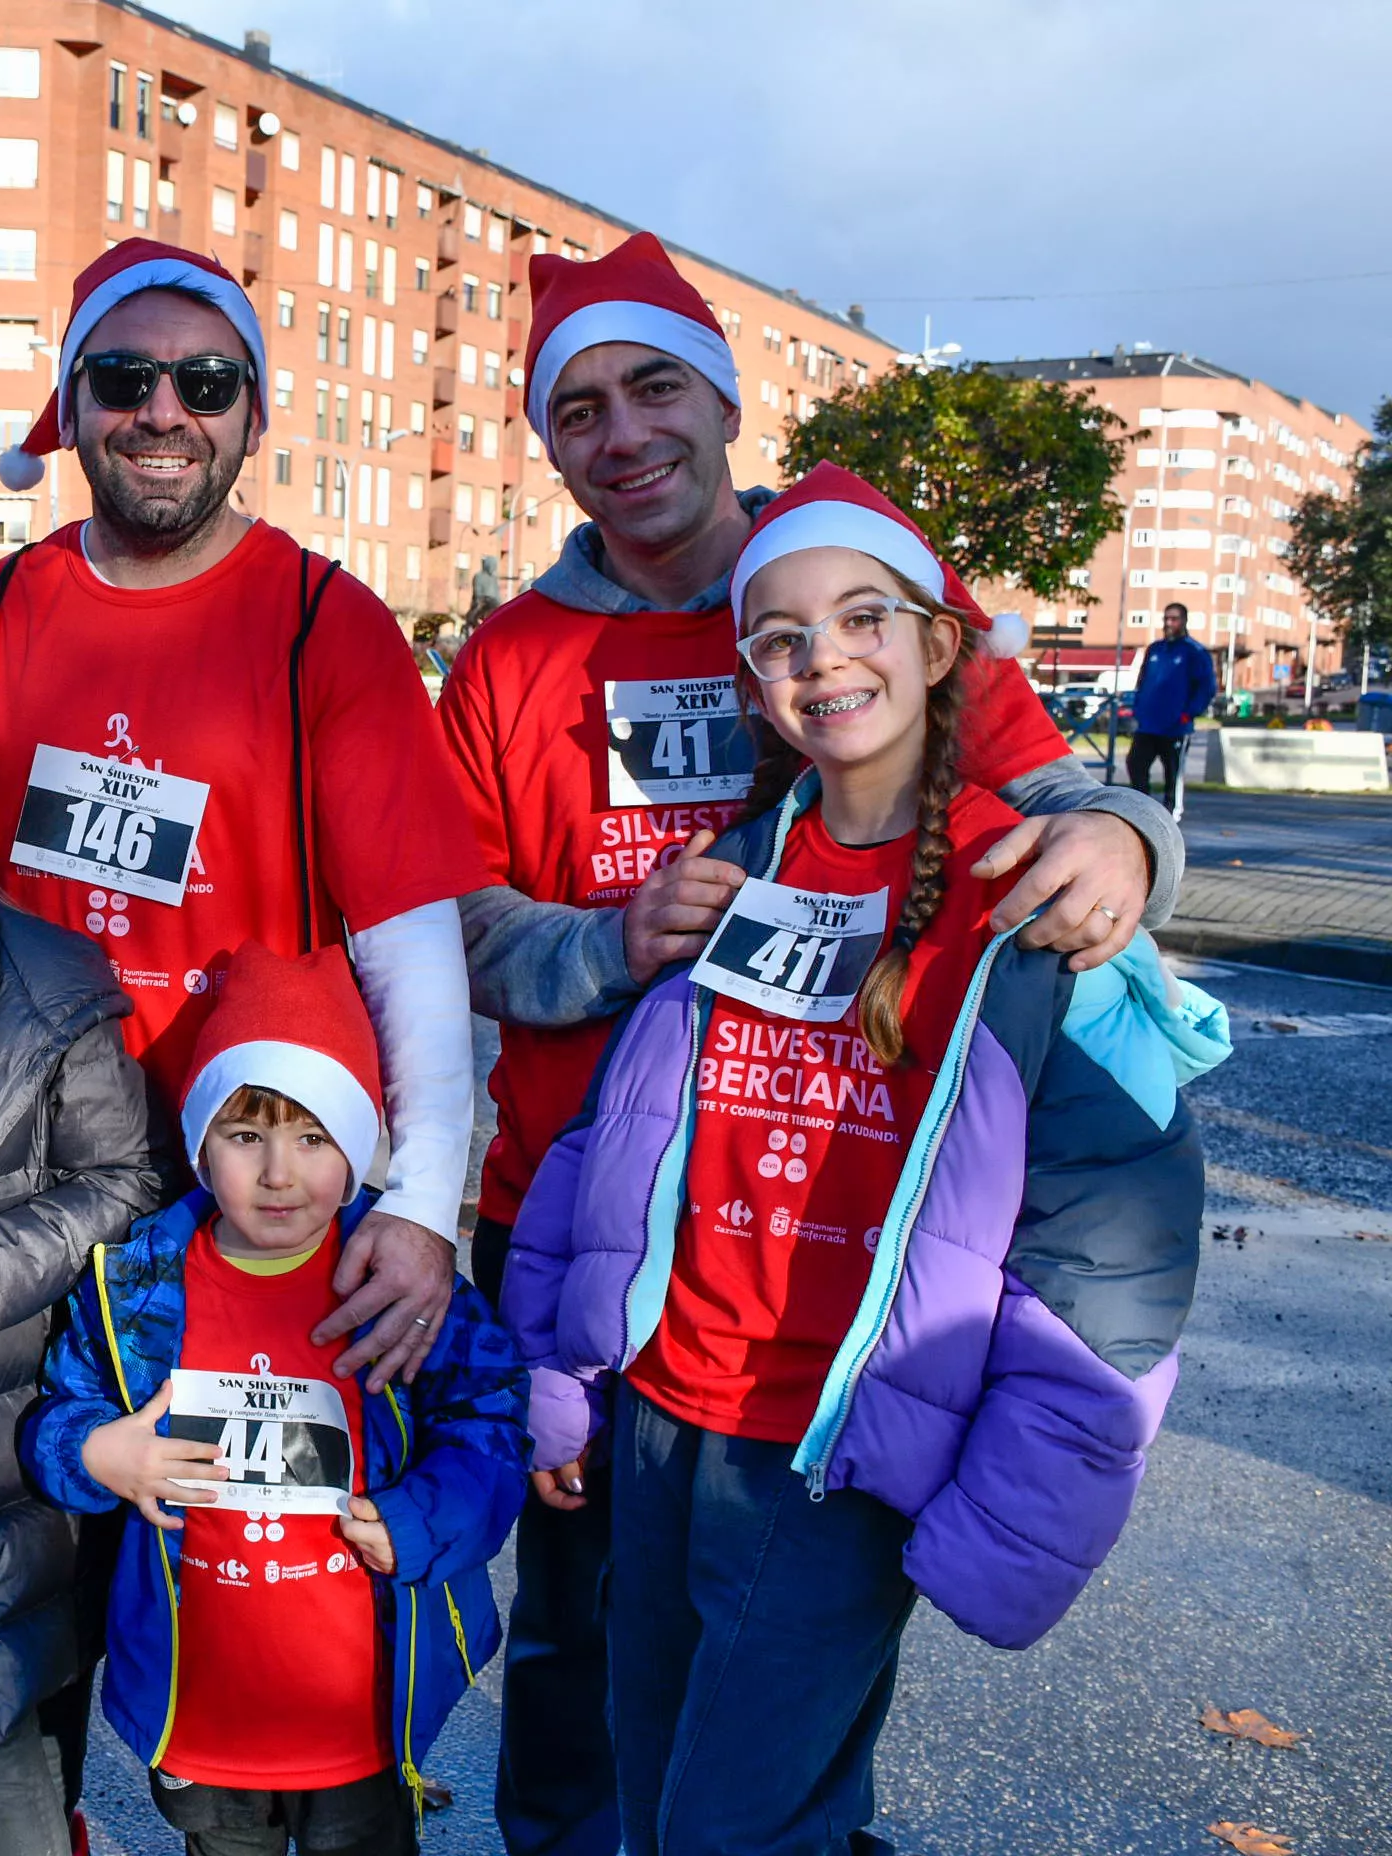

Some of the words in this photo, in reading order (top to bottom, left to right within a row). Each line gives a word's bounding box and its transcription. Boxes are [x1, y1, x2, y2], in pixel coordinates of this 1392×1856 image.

[650, 685, 674, 694] SAN
[675, 692, 723, 710] XLIV
[652, 720, 711, 776] 41
[80, 762, 104, 774] SAN
[107, 768, 160, 788] SILVESTRE
[98, 778, 144, 800] XLIV
[600, 805, 735, 847] SILVEST
[65, 800, 157, 871] 146
[591, 845, 686, 883] BERC
[793, 896, 817, 906] SAN
[809, 910, 852, 928] XLIV
[747, 929, 843, 995] 411
[122, 968, 170, 979] Ayuntamiento
[122, 977, 169, 988] Ponferrada
[714, 1020, 884, 1076] SILVESTRE
[697, 1058, 894, 1122] BERCIANA
[698, 1100, 716, 1112] ETE
[720, 1102, 726, 1112] Y
[730, 1105, 789, 1124] COMPARTE
[791, 1114, 834, 1131] TIEMPO
[714, 1224, 752, 1238] Carrefour
[793, 1218, 848, 1234] Ayuntamiento
[791, 1228, 846, 1244] Ponferrada
[218, 1378, 244, 1388] SAN
[248, 1380, 310, 1394] SILVESTRE
[244, 1391, 294, 1410] XLIV
[212, 1418, 286, 1484] 44
[194, 1556, 209, 1569] Roja
[282, 1561, 318, 1572] Ayuntamiento
[216, 1578, 250, 1588] Carrefour
[282, 1568, 318, 1580] Ponferrada
